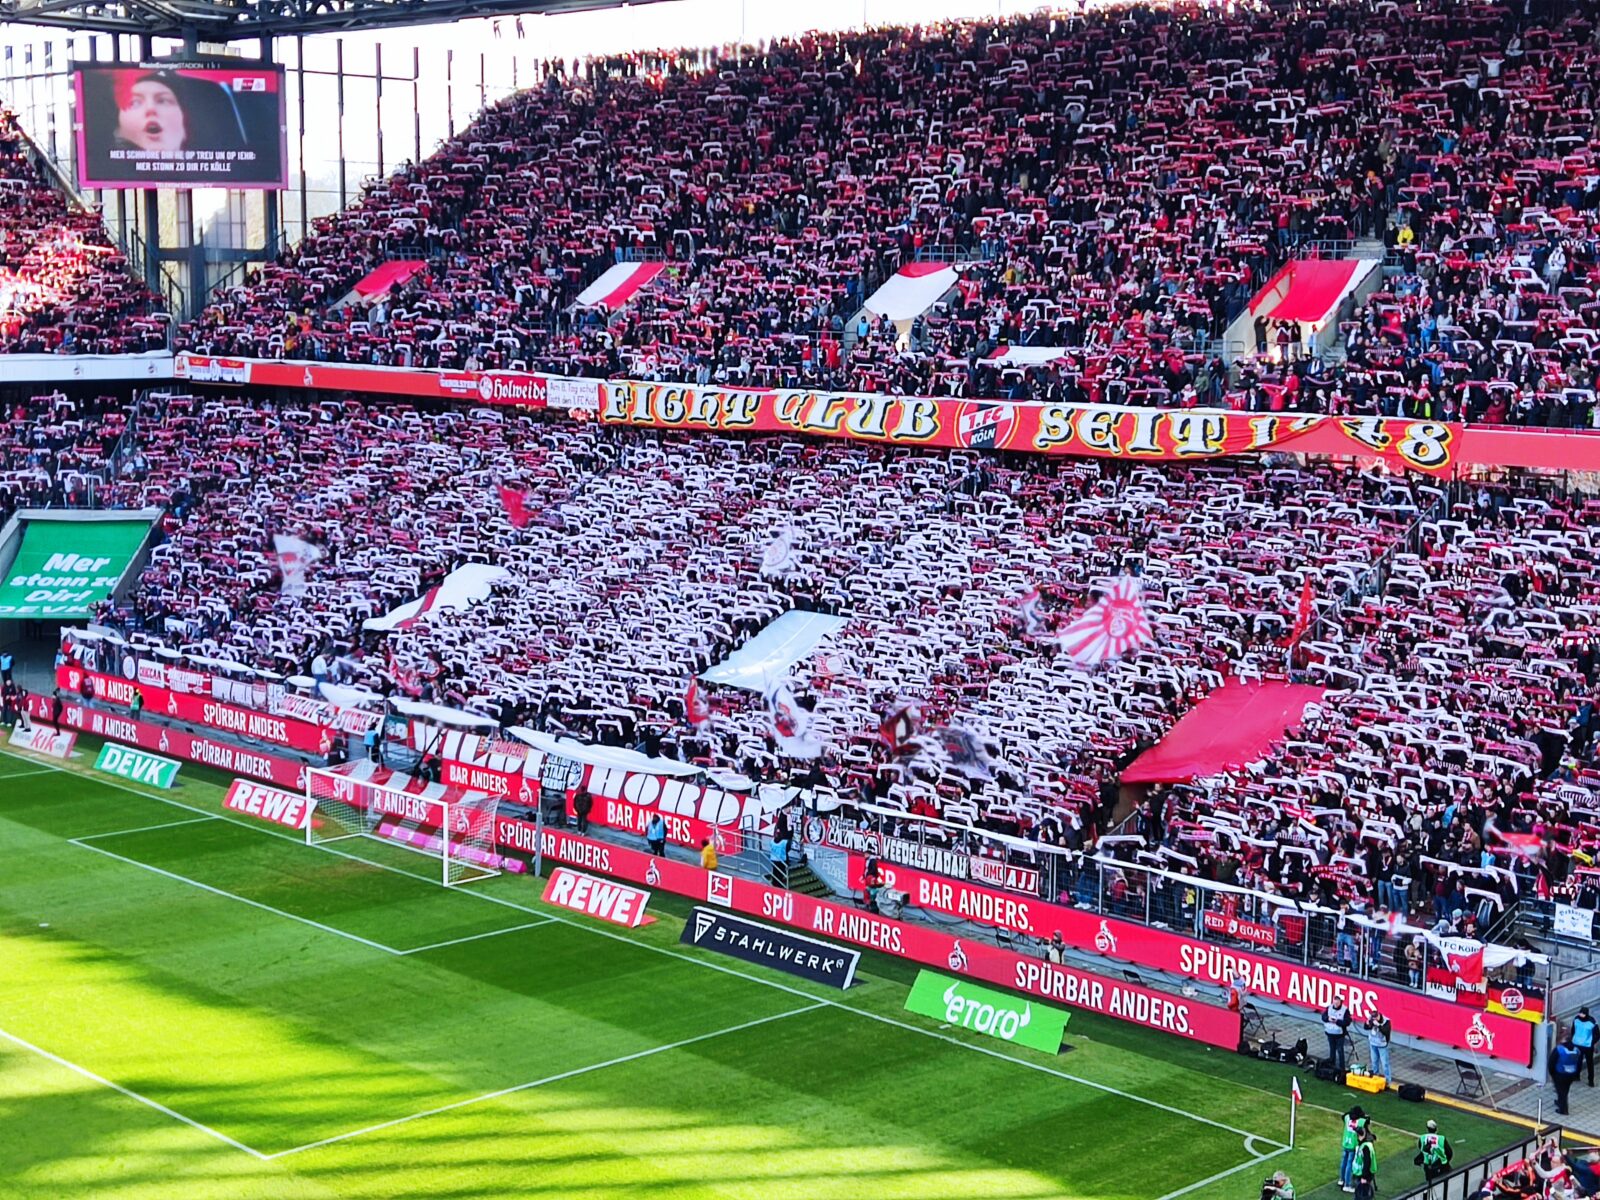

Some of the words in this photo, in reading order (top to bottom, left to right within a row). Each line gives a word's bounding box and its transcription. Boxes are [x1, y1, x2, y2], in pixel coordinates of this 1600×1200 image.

[136, 162, 151, 171] MER
[186, 162, 198, 171] DIR
[200, 162, 209, 171] FC
[603, 382, 762, 428] FIGHT
[776, 389, 938, 439] CLUB
[969, 406, 1004, 429] 1.FC
[971, 427, 996, 445] KÖLN
[1036, 406, 1226, 455] SEIT
[43, 553, 111, 572] Mer
[10, 574, 89, 587] stonn
[203, 702, 246, 732] SPÜRBAR
[101, 748, 167, 785] DEVK
[190, 740, 232, 768] SPÜRBAR
[449, 764, 469, 786] BAR
[230, 783, 301, 827] REWE
[607, 801, 633, 829] BAR
[1006, 868, 1036, 891] AJJ
[550, 873, 637, 925] REWE
[919, 878, 953, 911] BAR
[1204, 914, 1224, 928] RED
[1240, 925, 1273, 941] GOATS
[1015, 961, 1104, 1010] SPÜRBAR
[1109, 986, 1195, 1036] ANDERS.
